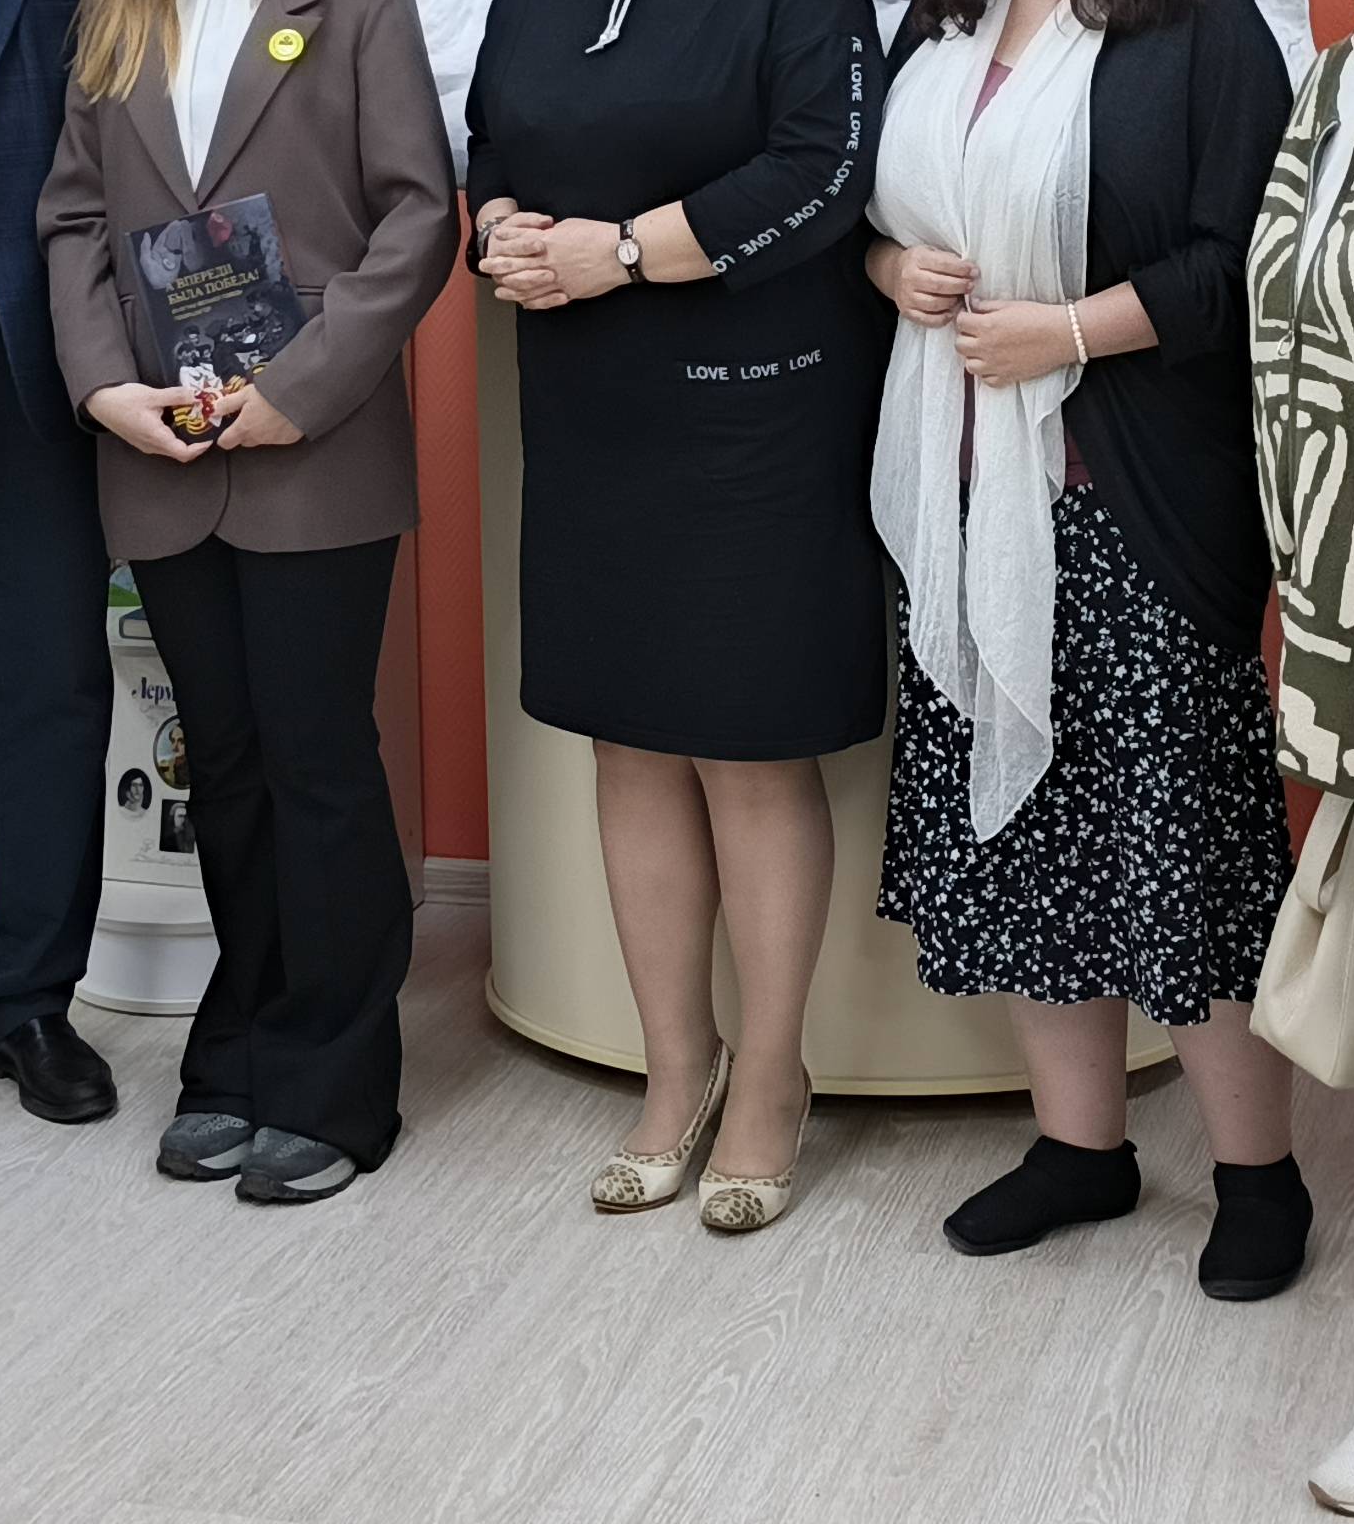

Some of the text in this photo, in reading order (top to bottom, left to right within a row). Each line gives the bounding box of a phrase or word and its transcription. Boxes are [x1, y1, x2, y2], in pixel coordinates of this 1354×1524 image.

[851, 63, 862, 102] LOVE
[846, 111, 862, 151] LOVE
[826, 160, 854, 196] LOVE
[783, 198, 825, 230] LOVE
[739, 228, 781, 258] LOVE
[687, 349, 823, 381] LOVE LOVE LOVE
